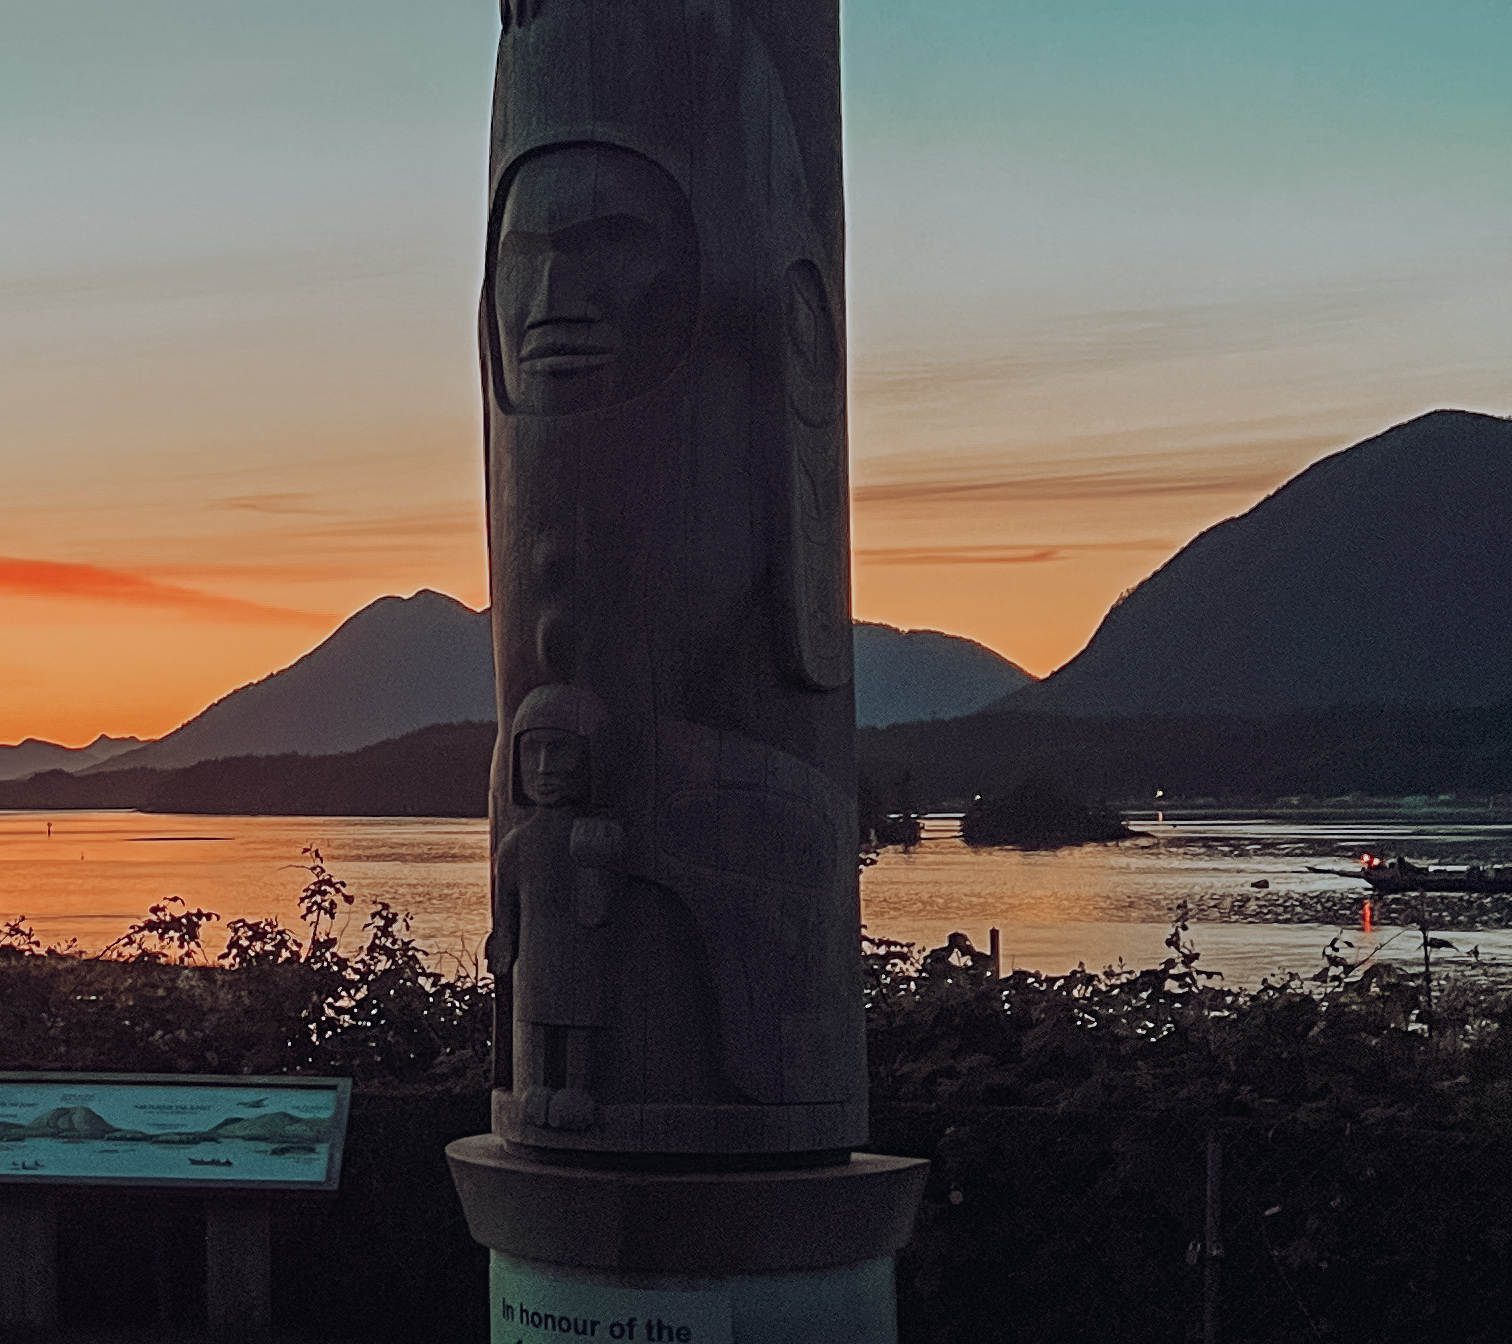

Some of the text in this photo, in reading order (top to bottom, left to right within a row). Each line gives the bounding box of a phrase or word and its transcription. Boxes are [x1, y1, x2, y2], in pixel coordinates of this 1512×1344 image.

[502, 1297, 692, 1343] In honour of the
